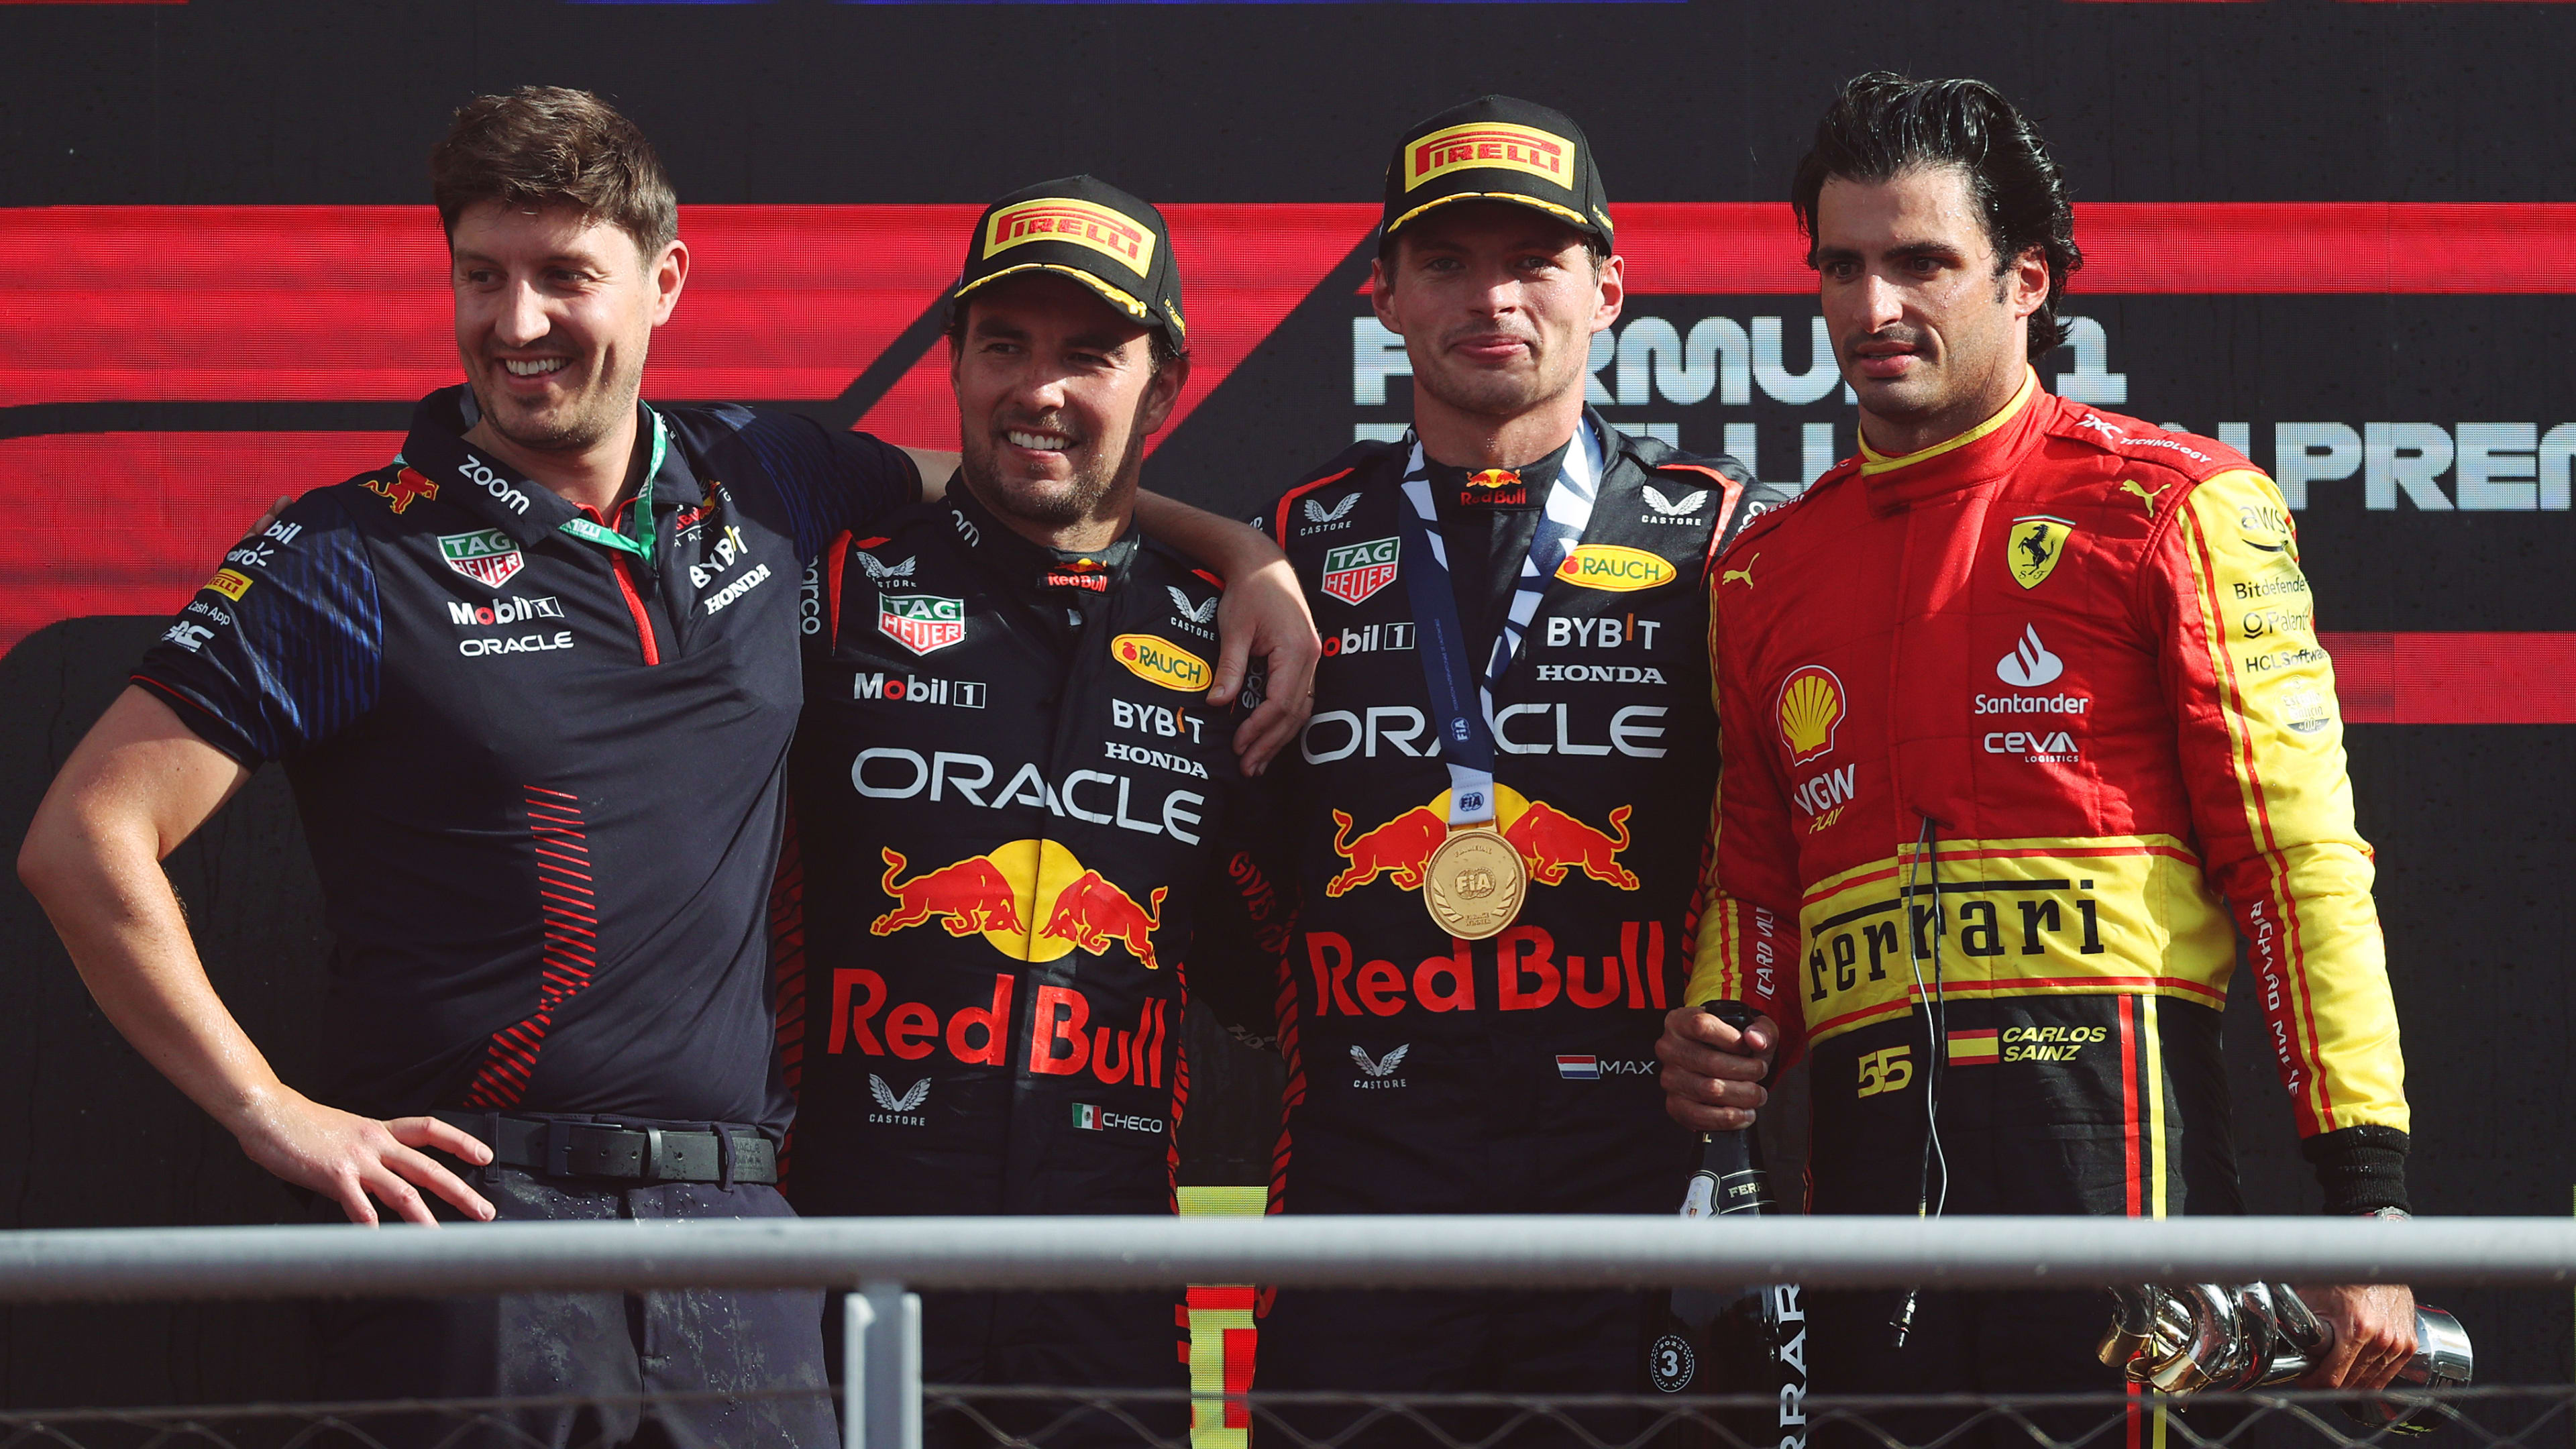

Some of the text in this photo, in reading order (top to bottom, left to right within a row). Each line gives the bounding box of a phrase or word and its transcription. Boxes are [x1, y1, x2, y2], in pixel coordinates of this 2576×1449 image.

[1415, 130, 1562, 178] PIRELLI
[994, 205, 1142, 260] PIRELLI
[2055, 316, 2127, 405] 1
[2120, 435, 2213, 464] TECHNOLOGY
[458, 453, 530, 516] zoom
[1493, 488, 1526, 504] Bull
[264, 520, 303, 545] bil
[1300, 520, 1352, 536] CASTORE
[1642, 515, 1702, 526] CASTORE
[2239, 505, 2286, 533] aws
[445, 532, 511, 557] TAG
[689, 525, 748, 589] BYBIT
[1333, 541, 1393, 569] TAG
[451, 551, 519, 586] HEUER
[1047, 572, 1108, 592] Red Bull
[1326, 566, 1393, 600] HEUER
[1582, 557, 1660, 581] RAUCH
[704, 564, 771, 615] HONDA
[207, 606, 231, 626] App
[447, 595, 533, 625] Mobil
[885, 599, 956, 619] TAG
[884, 614, 959, 650] HEUER
[1170, 616, 1216, 641] CASTORE
[1320, 625, 1379, 657] obil
[1547, 612, 1661, 650] BYBIT
[460, 631, 574, 657] ORACLE
[1139, 645, 1202, 684] RAUCH
[1536, 664, 1667, 685] HONDA
[853, 672, 948, 705] Mobil
[1974, 692, 2088, 714] Santander
[1112, 698, 1205, 745] BYBIT
[1300, 703, 1668, 765] ORCLE
[1105, 741, 1209, 780] HONDA
[2025, 755, 2079, 763] LOGISTICS
[851, 747, 1205, 846] ORACLE
[1793, 763, 1856, 816] VGW
[1809, 805, 1845, 835] PLAY
[1305, 921, 1667, 1017] Red Bull
[2250, 900, 2281, 1012] RICHARD
[826, 967, 1167, 1089] Red Bull
[2002, 1026, 2107, 1043] CARLOS
[1600, 1061, 1655, 1075] MAX
[2004, 1044, 2082, 1063] SAINZ
[1353, 1079, 1407, 1089] CASTORE
[1857, 1044, 1913, 1098] 55
[869, 1113, 926, 1126] CASTORE
[1102, 1112, 1163, 1134] CHECO
[1660, 1350, 1678, 1377] 3
